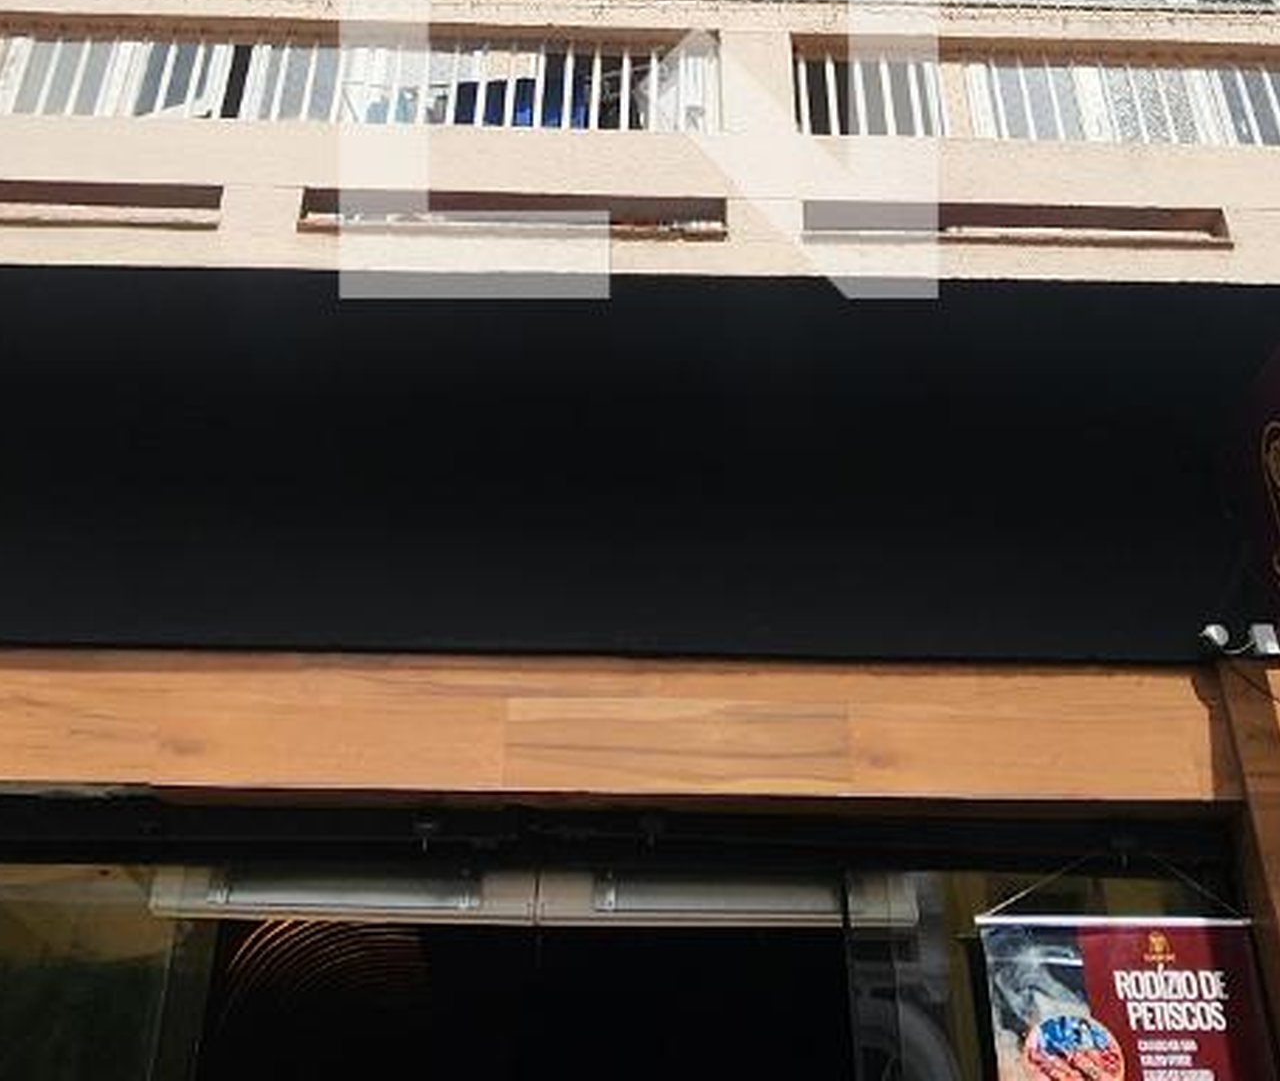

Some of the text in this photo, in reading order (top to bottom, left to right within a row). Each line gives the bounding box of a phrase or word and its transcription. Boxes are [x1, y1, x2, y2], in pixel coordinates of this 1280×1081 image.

[1112, 962, 1229, 1000] RODÍZIO DE
[1126, 1001, 1227, 1031] PETISCOS
